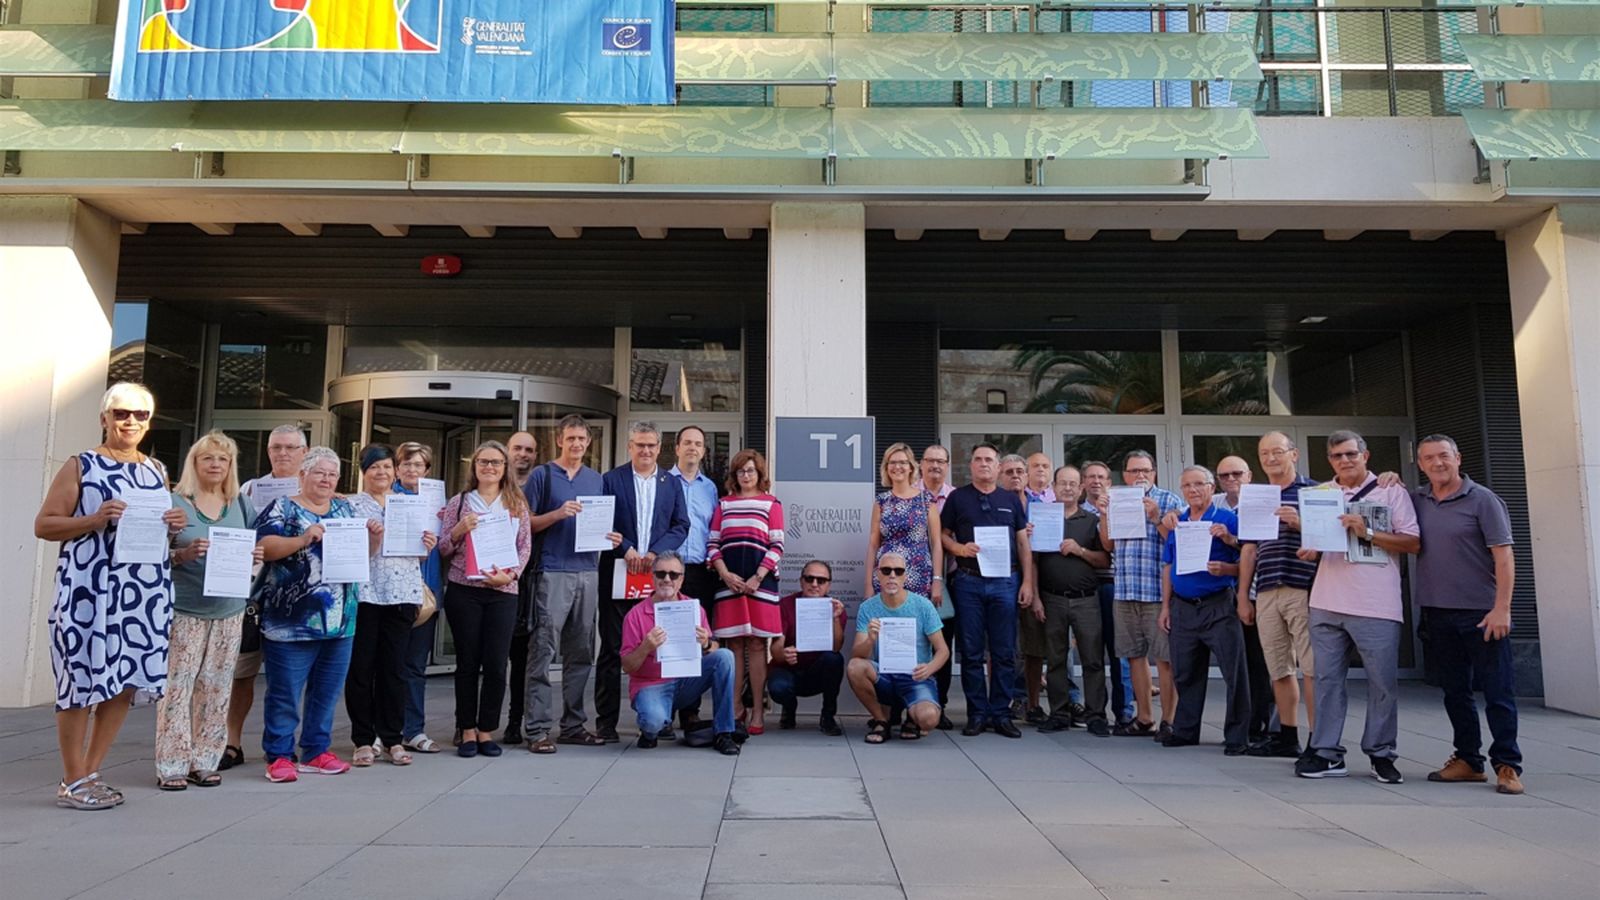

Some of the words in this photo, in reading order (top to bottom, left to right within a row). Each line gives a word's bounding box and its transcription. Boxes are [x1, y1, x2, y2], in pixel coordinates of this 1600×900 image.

[475, 21, 526, 32] GENERALITAT
[475, 32, 526, 42] VALENCIANA
[805, 508, 862, 521] GENERALITAT
[805, 521, 863, 533] VALENCIANA
